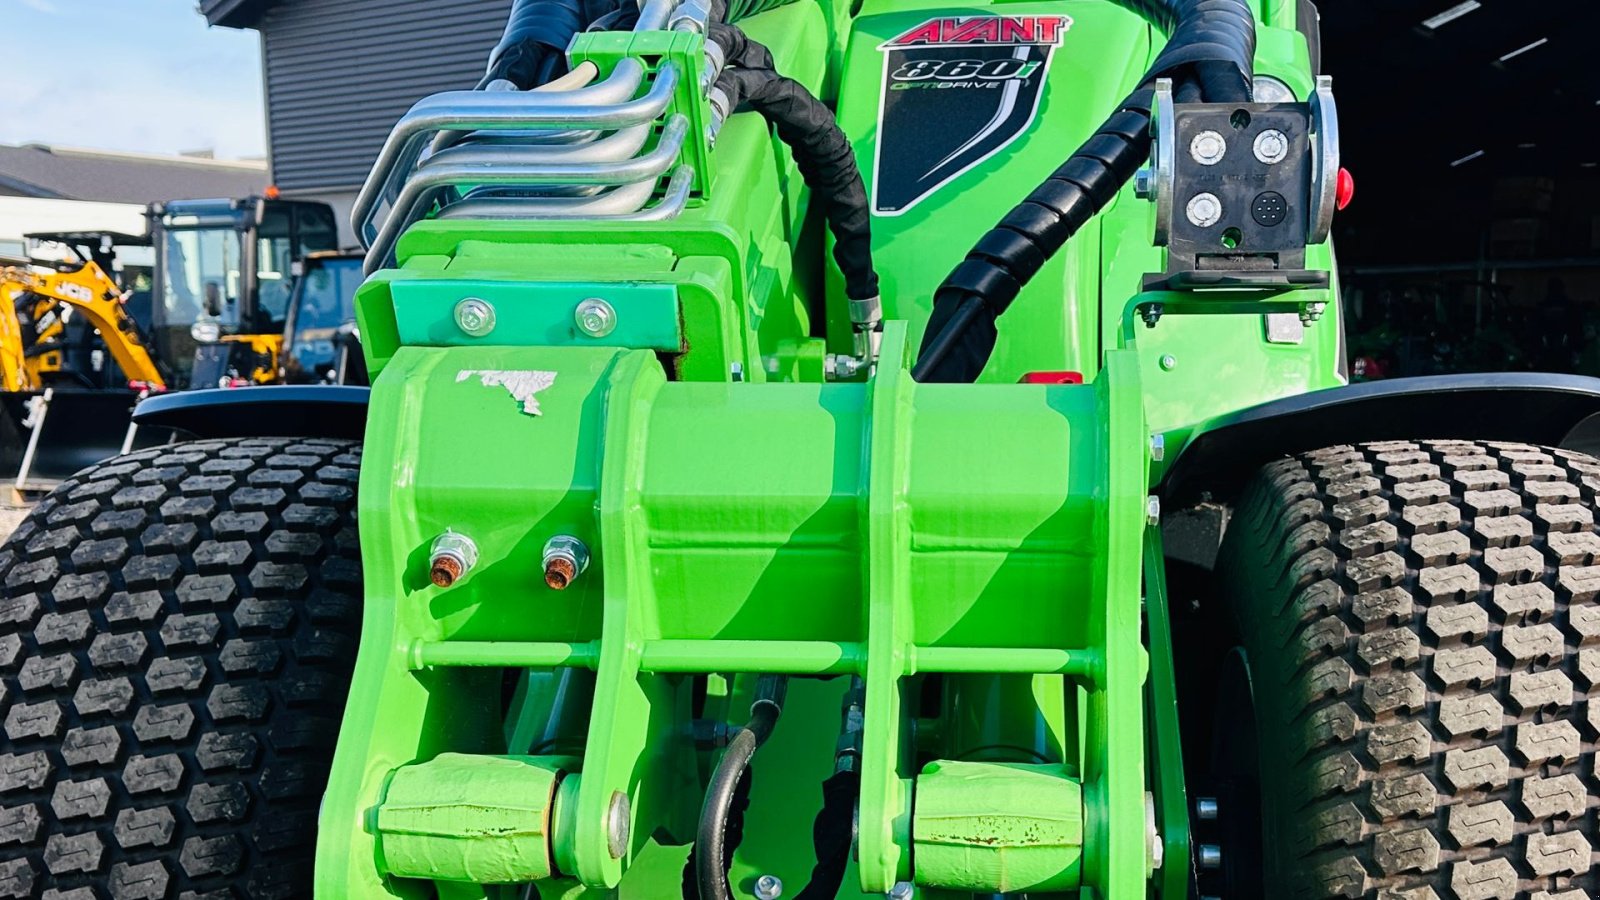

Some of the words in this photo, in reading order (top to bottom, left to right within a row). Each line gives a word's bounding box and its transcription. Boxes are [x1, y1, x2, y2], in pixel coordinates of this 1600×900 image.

[893, 16, 1063, 45] AVANT
[891, 59, 1043, 80] 860i
[889, 81, 1001, 91] OPTIDRIVE
[55, 281, 92, 303] JCB
